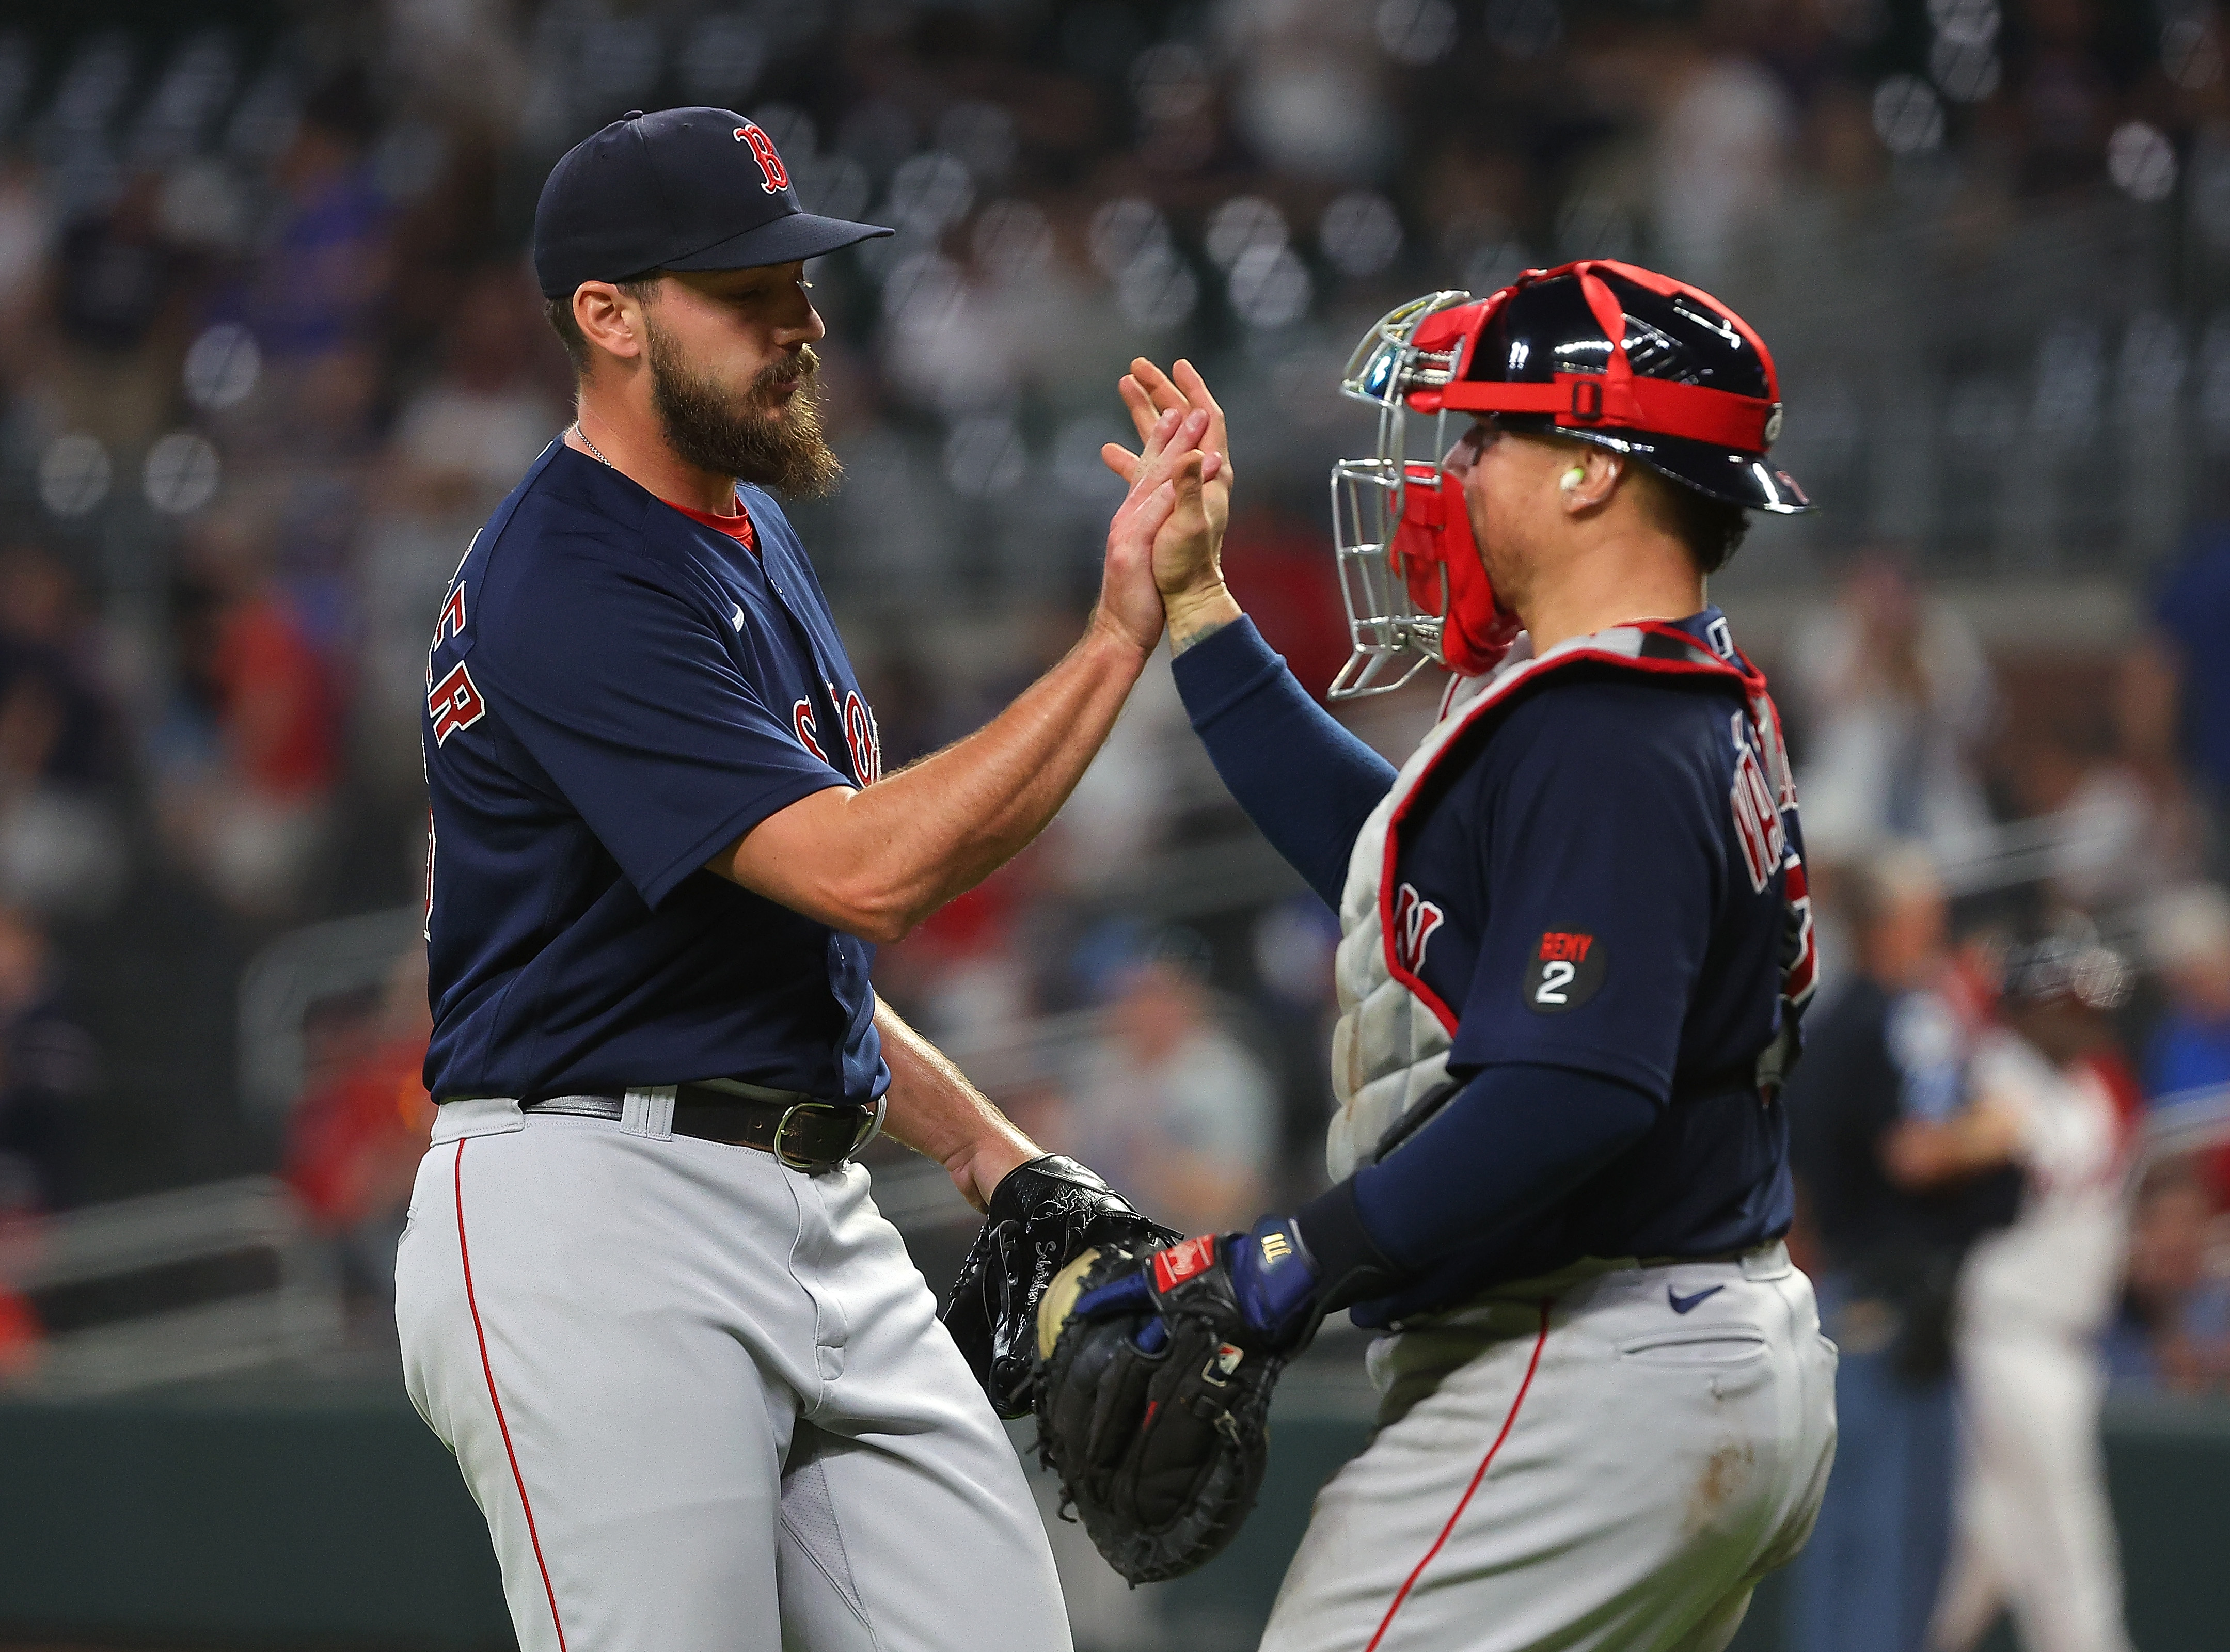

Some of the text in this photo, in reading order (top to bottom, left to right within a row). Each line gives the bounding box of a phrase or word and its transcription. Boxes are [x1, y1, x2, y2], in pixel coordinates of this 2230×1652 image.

[732, 124, 788, 195] B
[426, 532, 485, 749] ER
[1539, 932, 1594, 963] REMY
[1535, 960, 1575, 1004] 2
